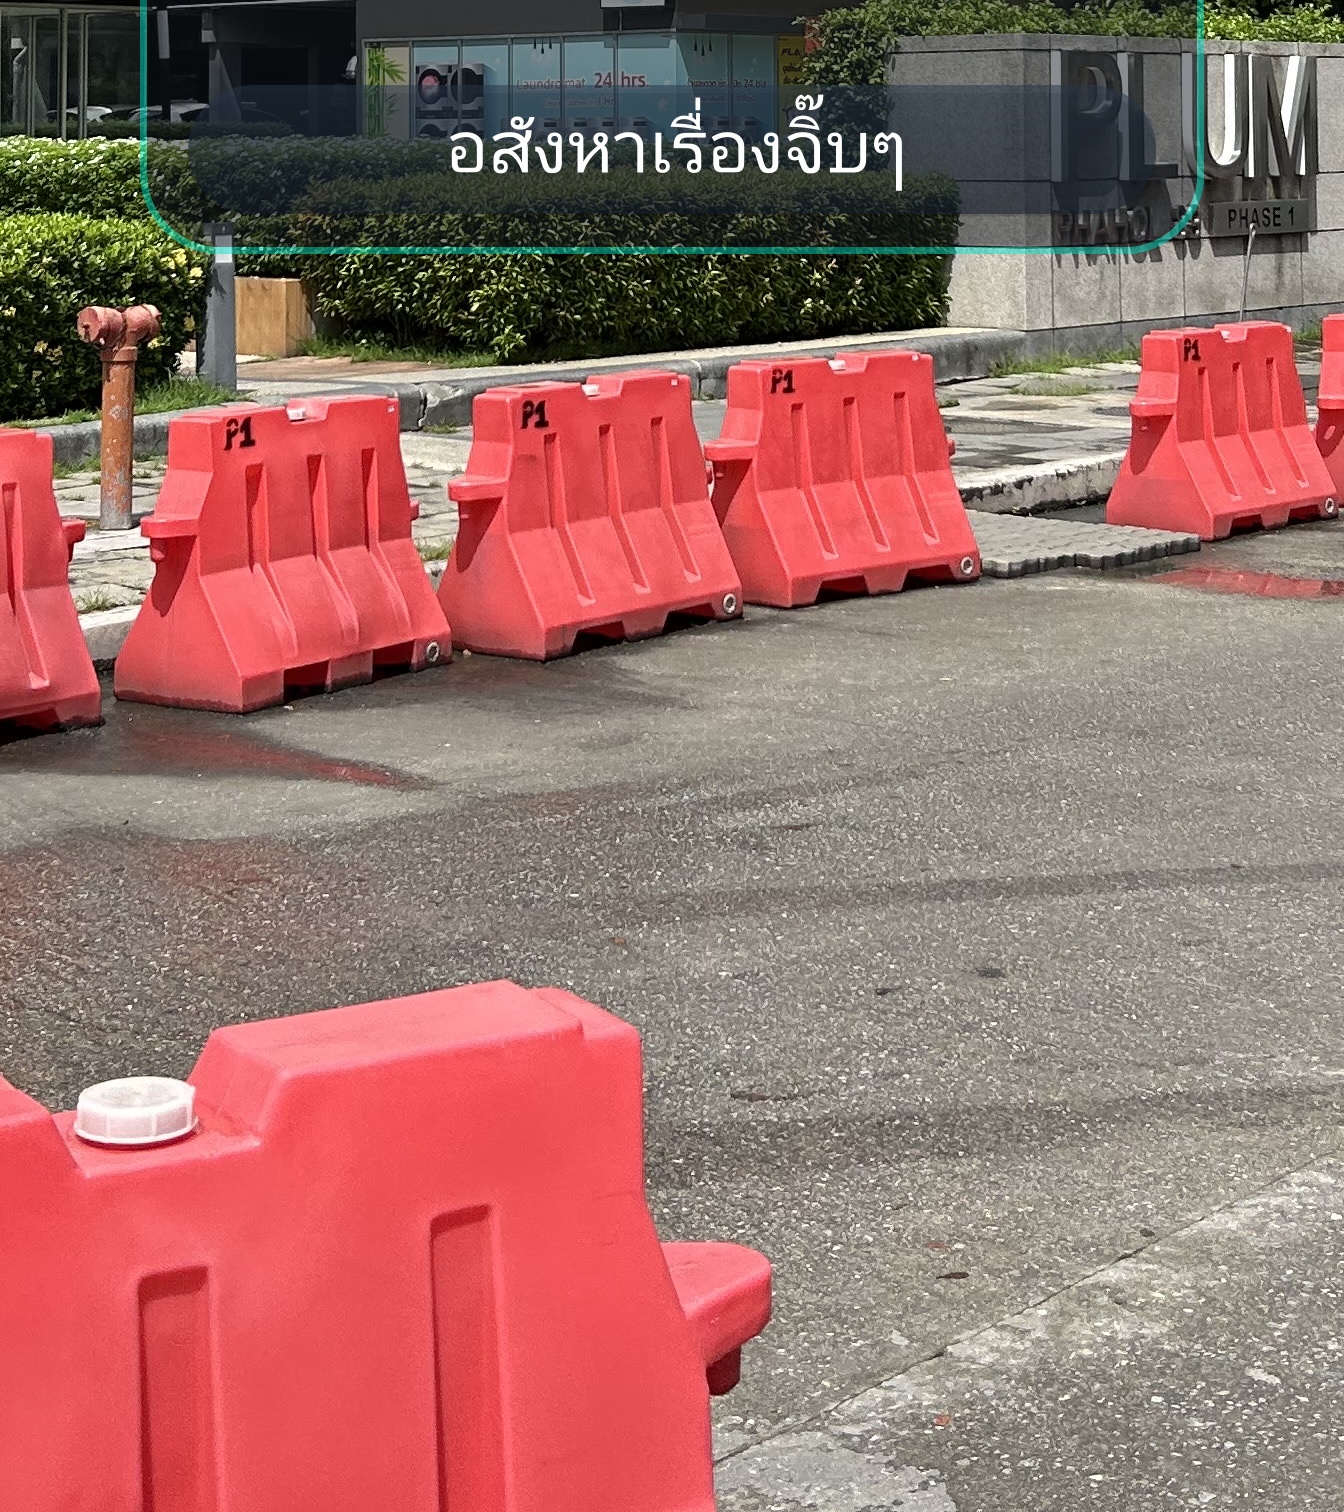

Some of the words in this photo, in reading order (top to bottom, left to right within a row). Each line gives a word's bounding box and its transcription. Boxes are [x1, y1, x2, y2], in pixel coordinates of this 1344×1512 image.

[594, 72, 613, 88] 24
[1227, 206, 1282, 229] PHASE
[1288, 206, 1296, 226] 1
[1183, 338, 1202, 362] P1
[770, 368, 796, 395] P1
[520, 399, 550, 430] P1
[224, 416, 256, 452] P1
